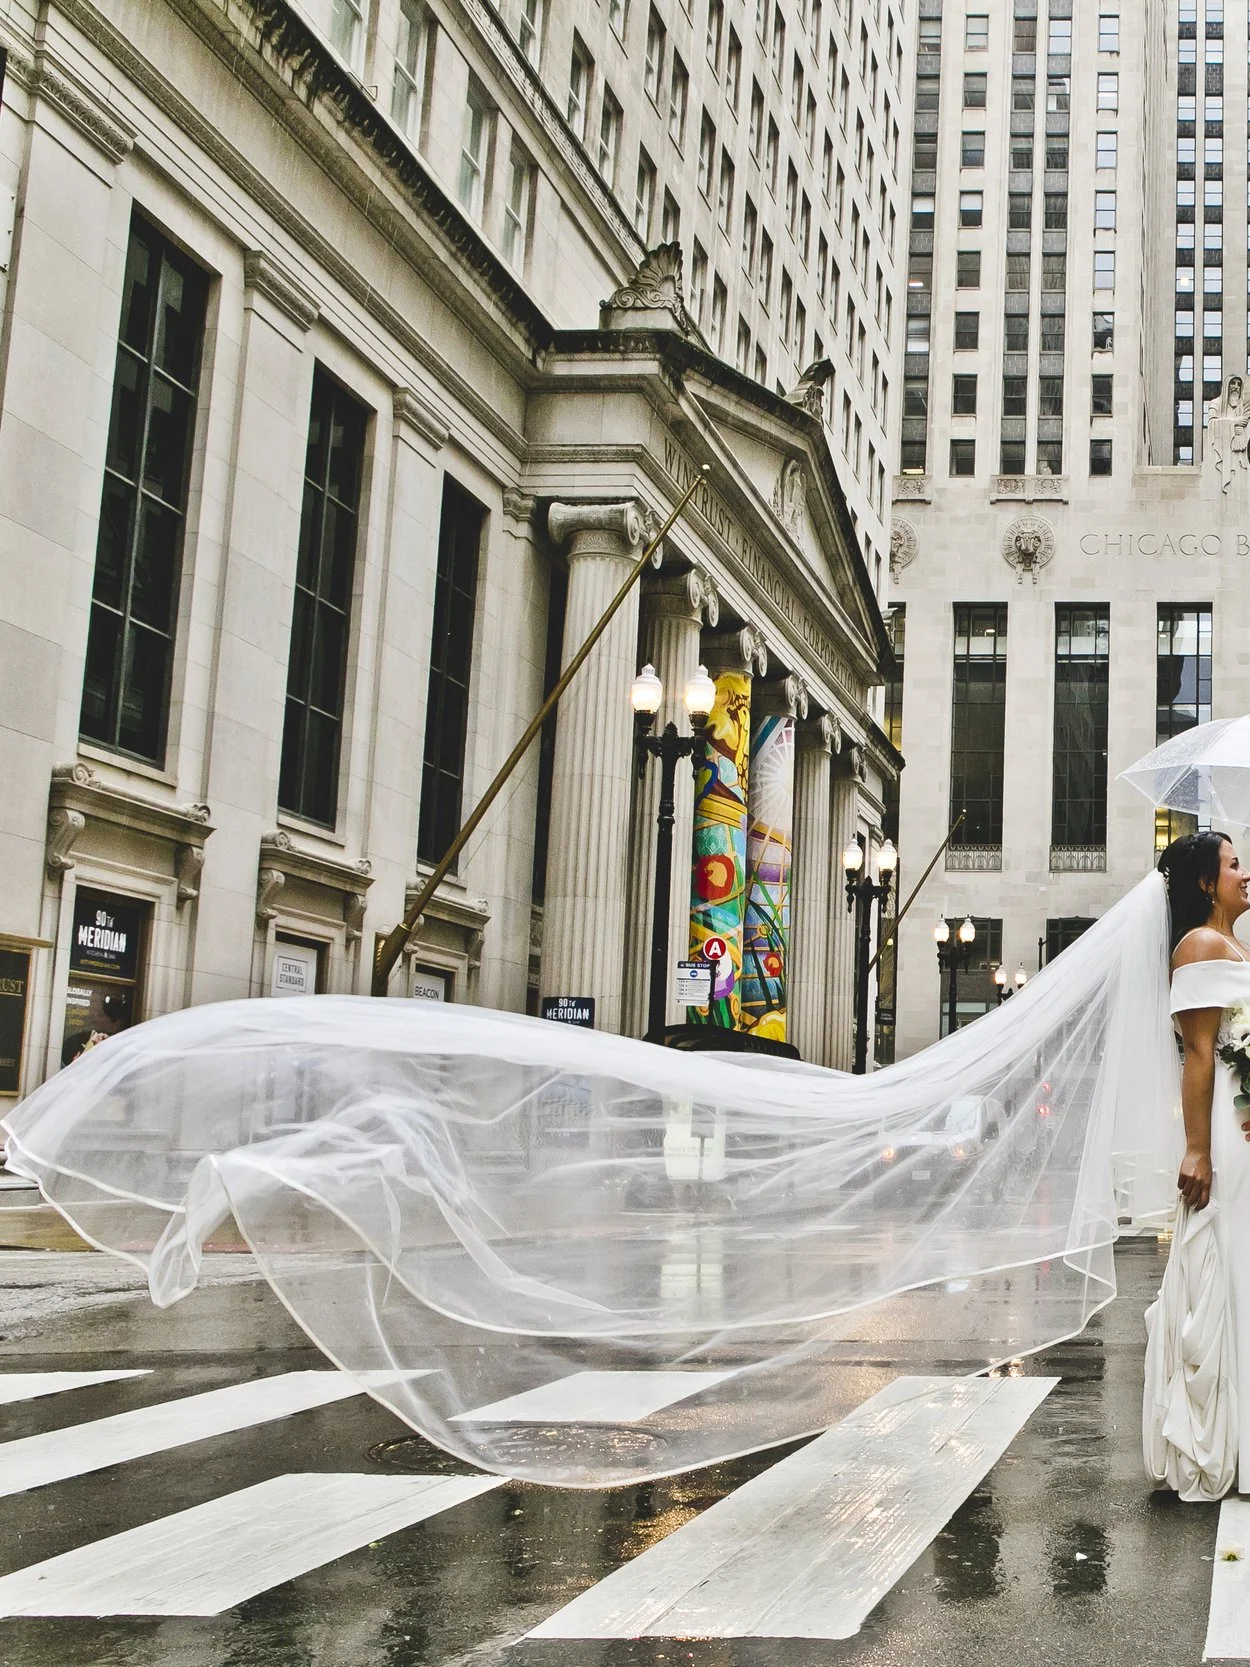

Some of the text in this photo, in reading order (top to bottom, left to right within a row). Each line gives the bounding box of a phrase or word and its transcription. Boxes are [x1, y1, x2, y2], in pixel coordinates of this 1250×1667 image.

[1079, 533, 1223, 557] CHICAGO
[741, 537, 797, 624] FINANCIAL
[803, 616, 858, 701] CORPORATION
[78, 925, 127, 952] MERIDIAN
[708, 941, 722, 956] A
[414, 985, 440, 1000] BEACON
[546, 1007, 590, 1020] MERIDIAN
